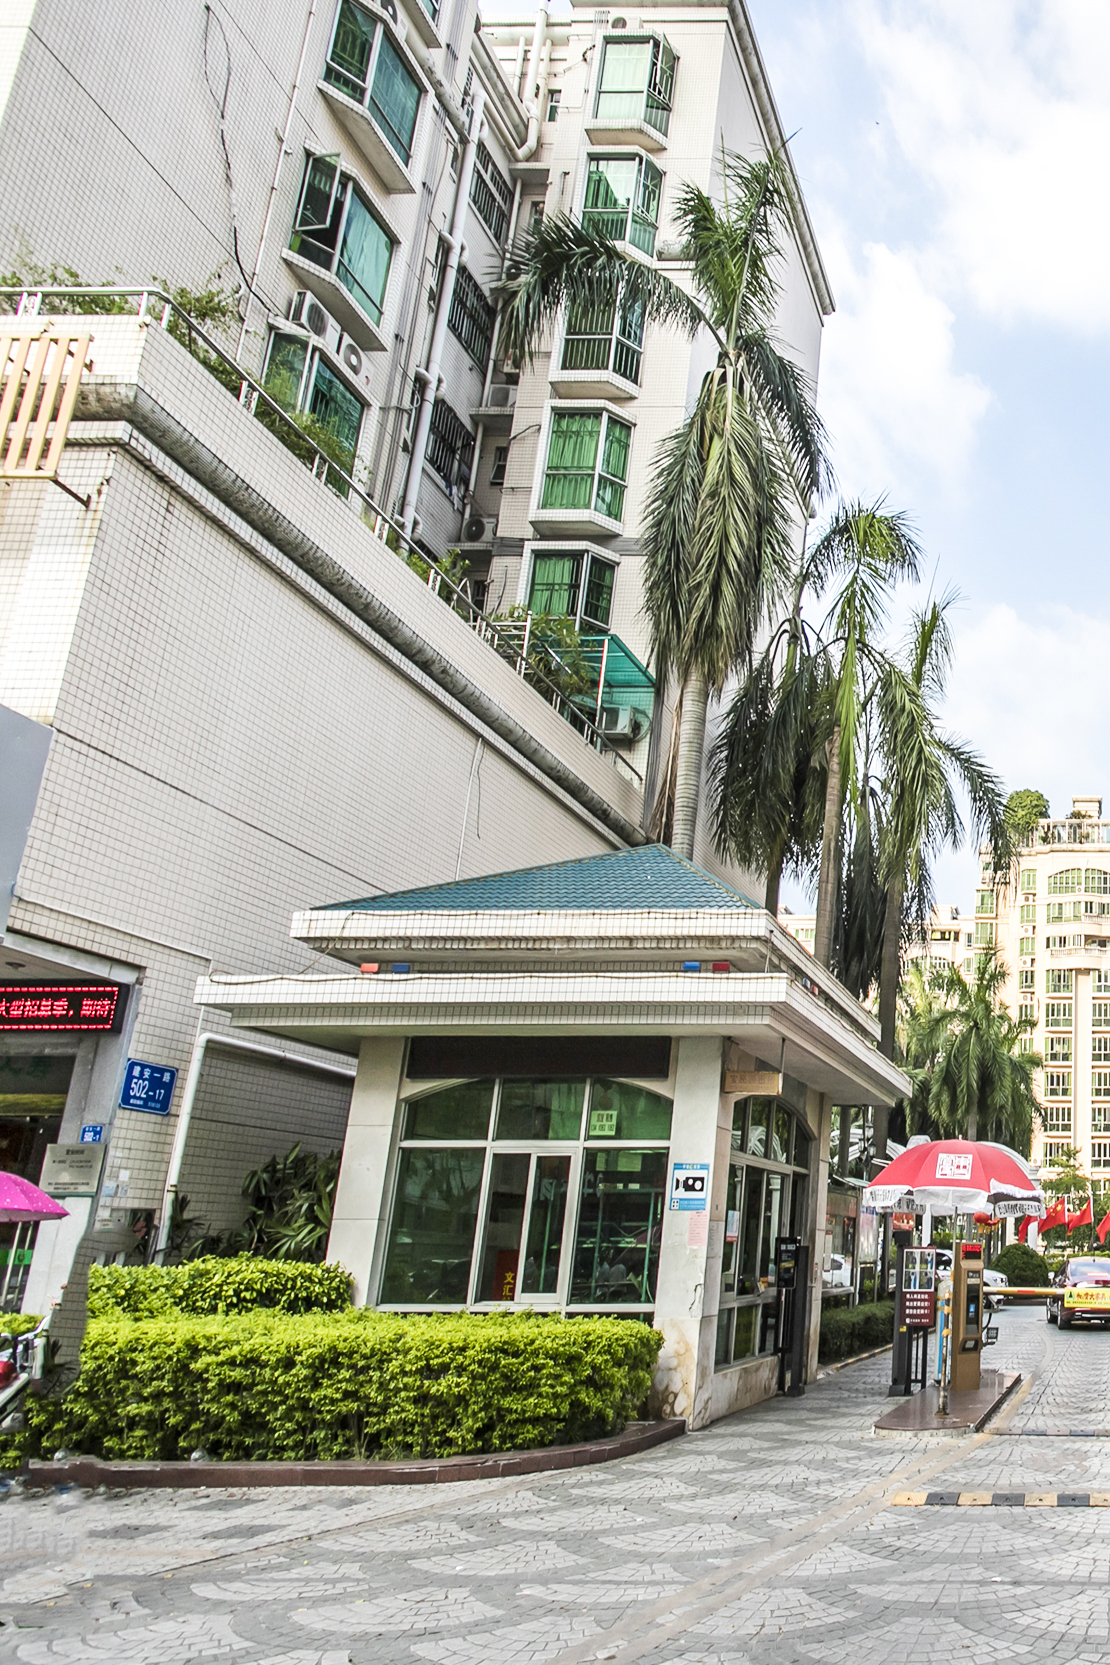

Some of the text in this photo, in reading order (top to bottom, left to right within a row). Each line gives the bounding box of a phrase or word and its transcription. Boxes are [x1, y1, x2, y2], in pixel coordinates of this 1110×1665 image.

[132, 1065, 171, 1083] 建安一路
[130, 1079, 165, 1101] 502-17
